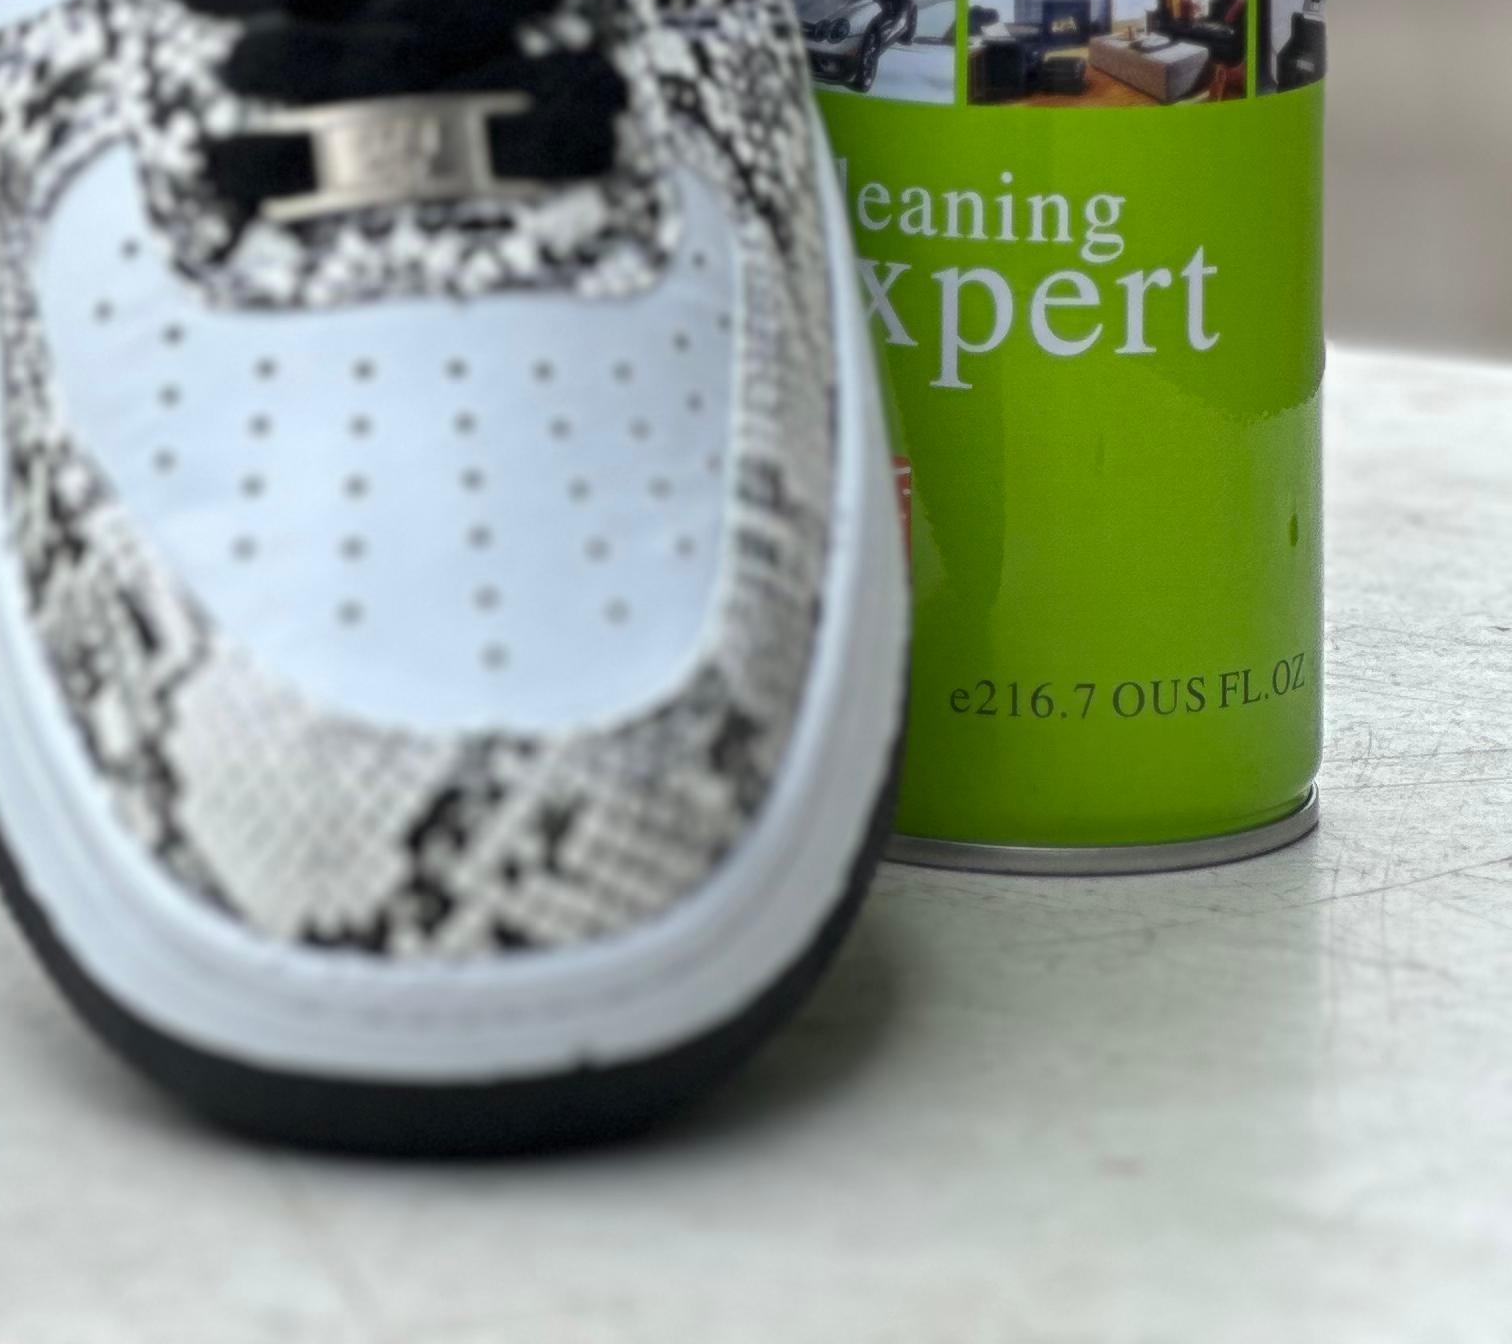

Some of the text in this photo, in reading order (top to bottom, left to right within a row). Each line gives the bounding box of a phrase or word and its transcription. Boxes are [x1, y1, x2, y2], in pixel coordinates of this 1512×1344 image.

[831, 158, 1126, 263] leaning
[855, 245, 1221, 390] xpert
[948, 679, 1097, 720] e216.7
[1112, 675, 1208, 718] OUS
